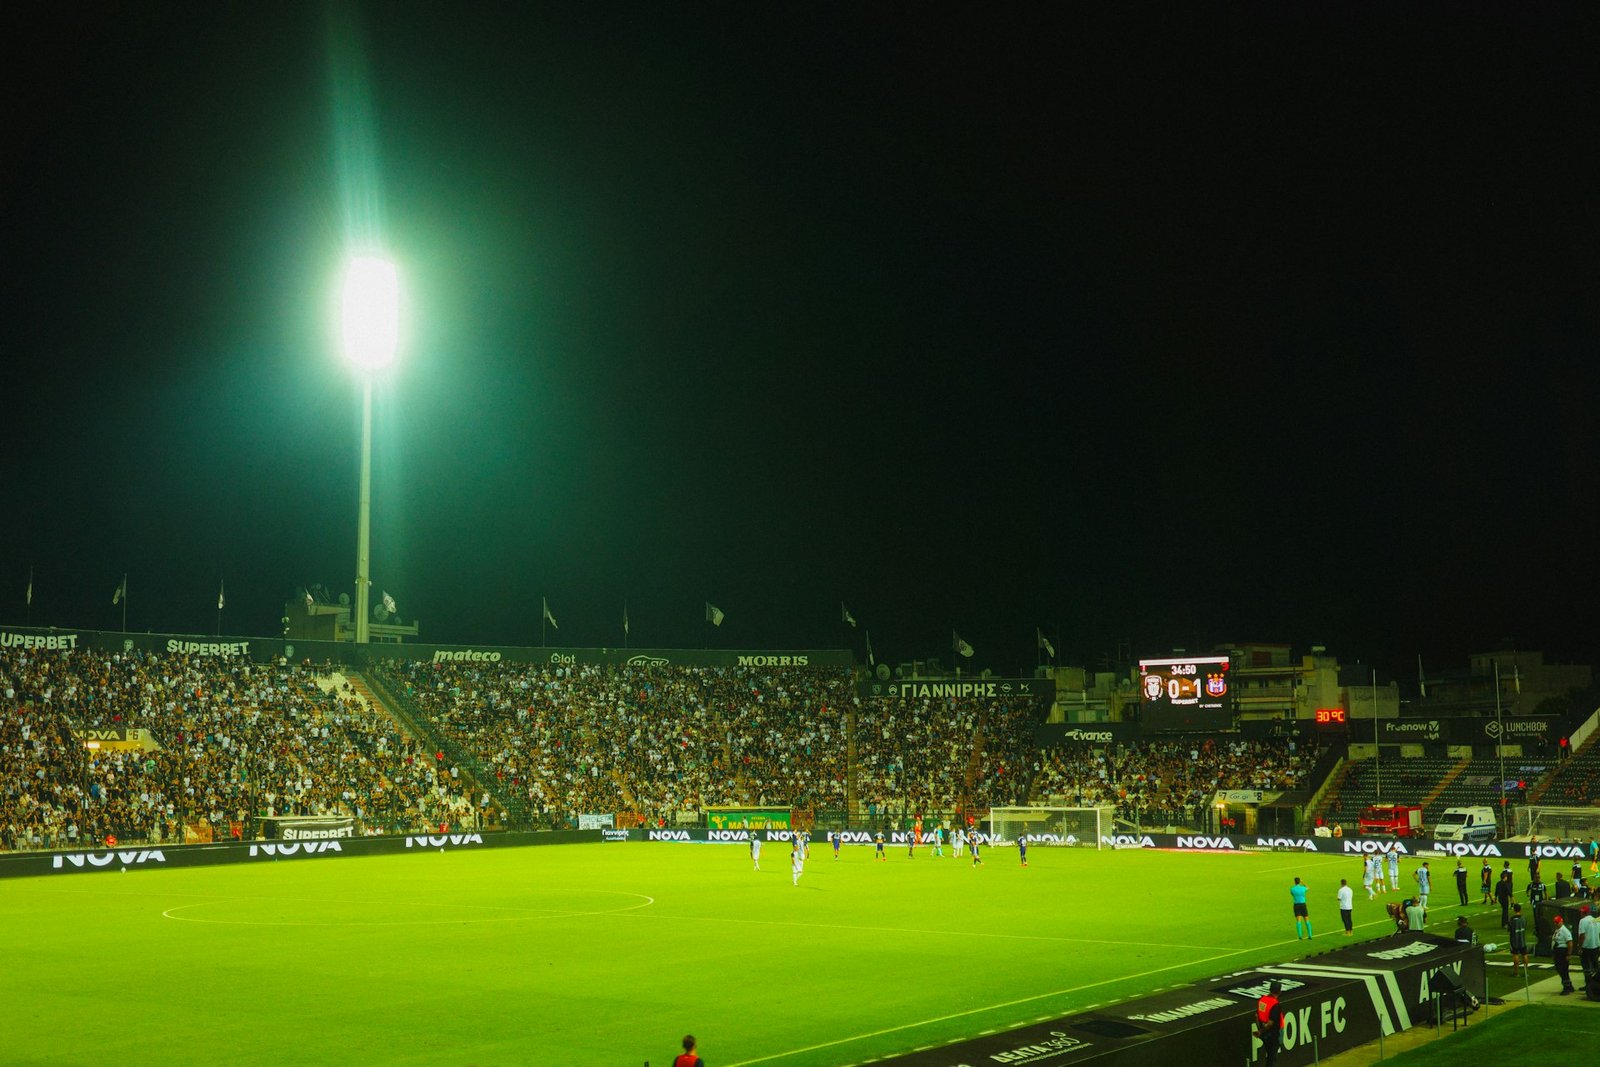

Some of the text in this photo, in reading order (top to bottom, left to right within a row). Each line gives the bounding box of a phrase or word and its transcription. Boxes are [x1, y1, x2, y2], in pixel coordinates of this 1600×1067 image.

[0, 632, 78, 650] UPERBET
[166, 639, 249, 656] SUPERBET
[433, 650, 501, 663] mateco
[737, 655, 808, 666] MORRIS
[1171, 664, 1197, 675] 34:50
[901, 683, 996, 698] ΓΙΑΝΝΙΡΗΣ
[1317, 711, 1330, 722] 30
[1506, 721, 1548, 732] LUNCHBOX
[406, 833, 483, 848] NOVA
[650, 830, 691, 841] NOVA
[708, 830, 749, 841] NOVA
[1101, 834, 1156, 847] NOVA
[250, 841, 342, 857] NOVA
[1176, 836, 1235, 849] NOVA
[1257, 838, 1318, 851] NOVA
[1343, 840, 1409, 854] NOVA
[1434, 842, 1502, 856] NOVA
[53, 850, 166, 868] NOVA
[1251, 996, 1347, 1062] POK FC
